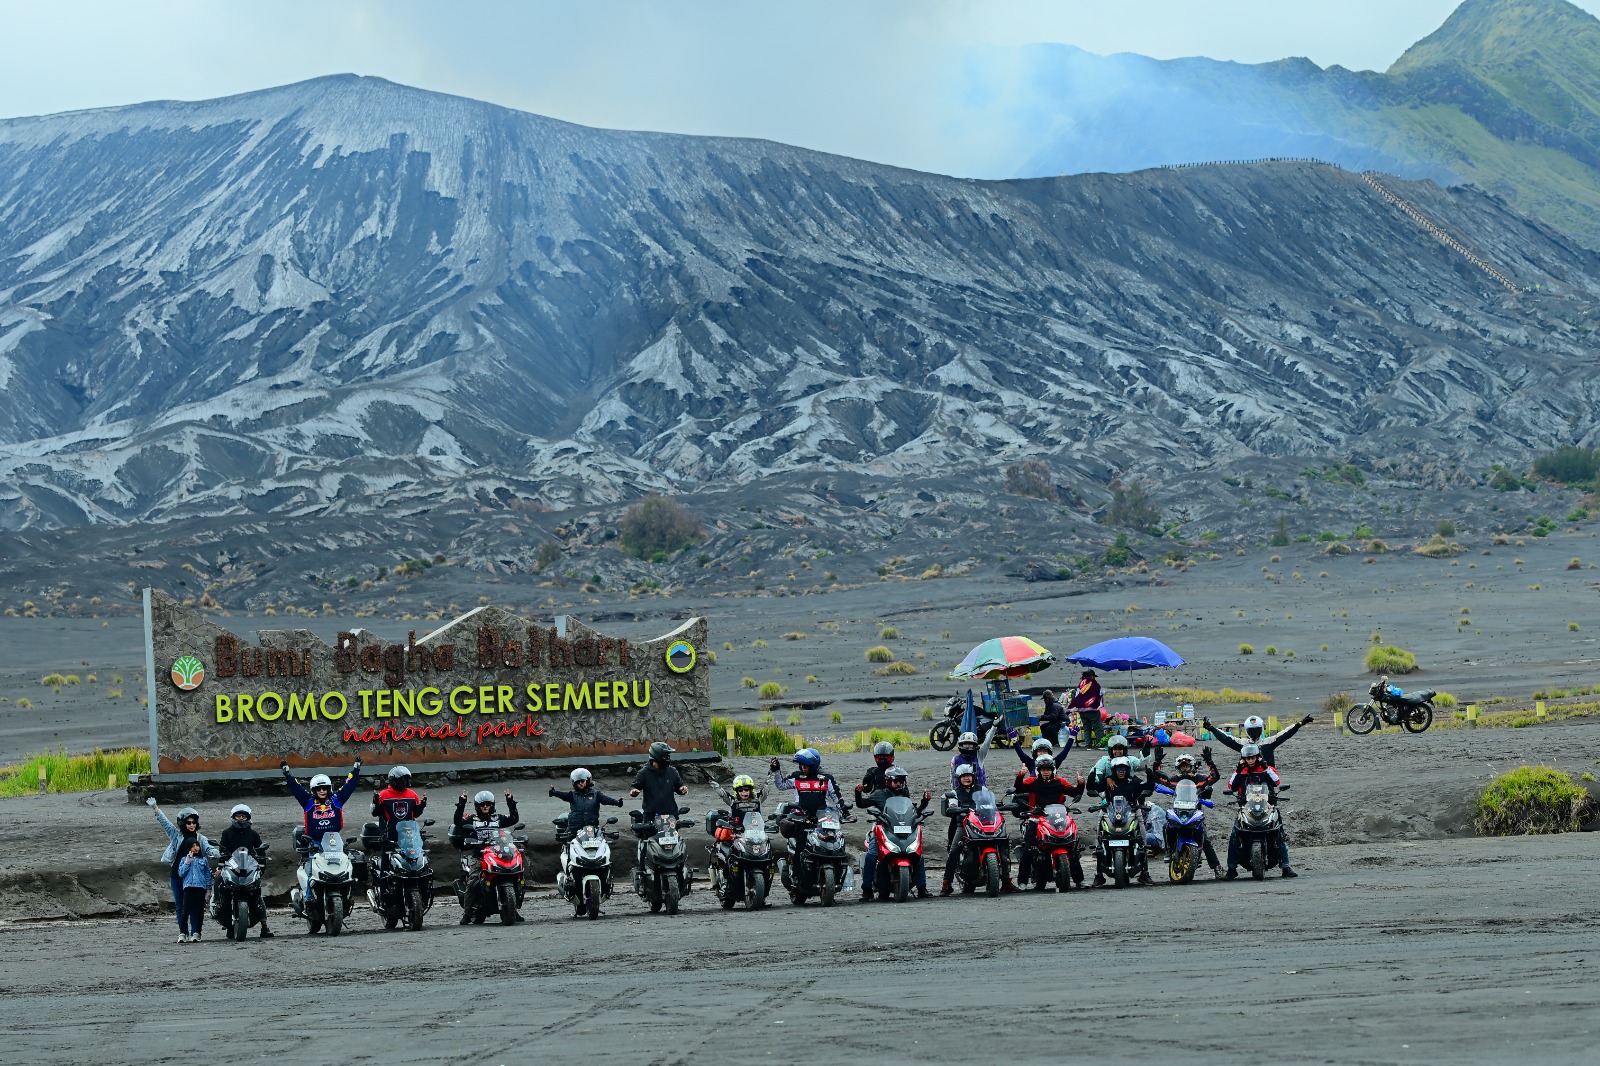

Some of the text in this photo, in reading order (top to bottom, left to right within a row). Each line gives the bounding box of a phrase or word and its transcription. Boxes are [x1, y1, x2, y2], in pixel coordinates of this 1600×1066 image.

[215, 634, 312, 678] Bumi
[337, 630, 453, 687] Bagha
[215, 680, 651, 723] BROMO TENGGER SEMERU
[343, 714, 545, 744] national park
